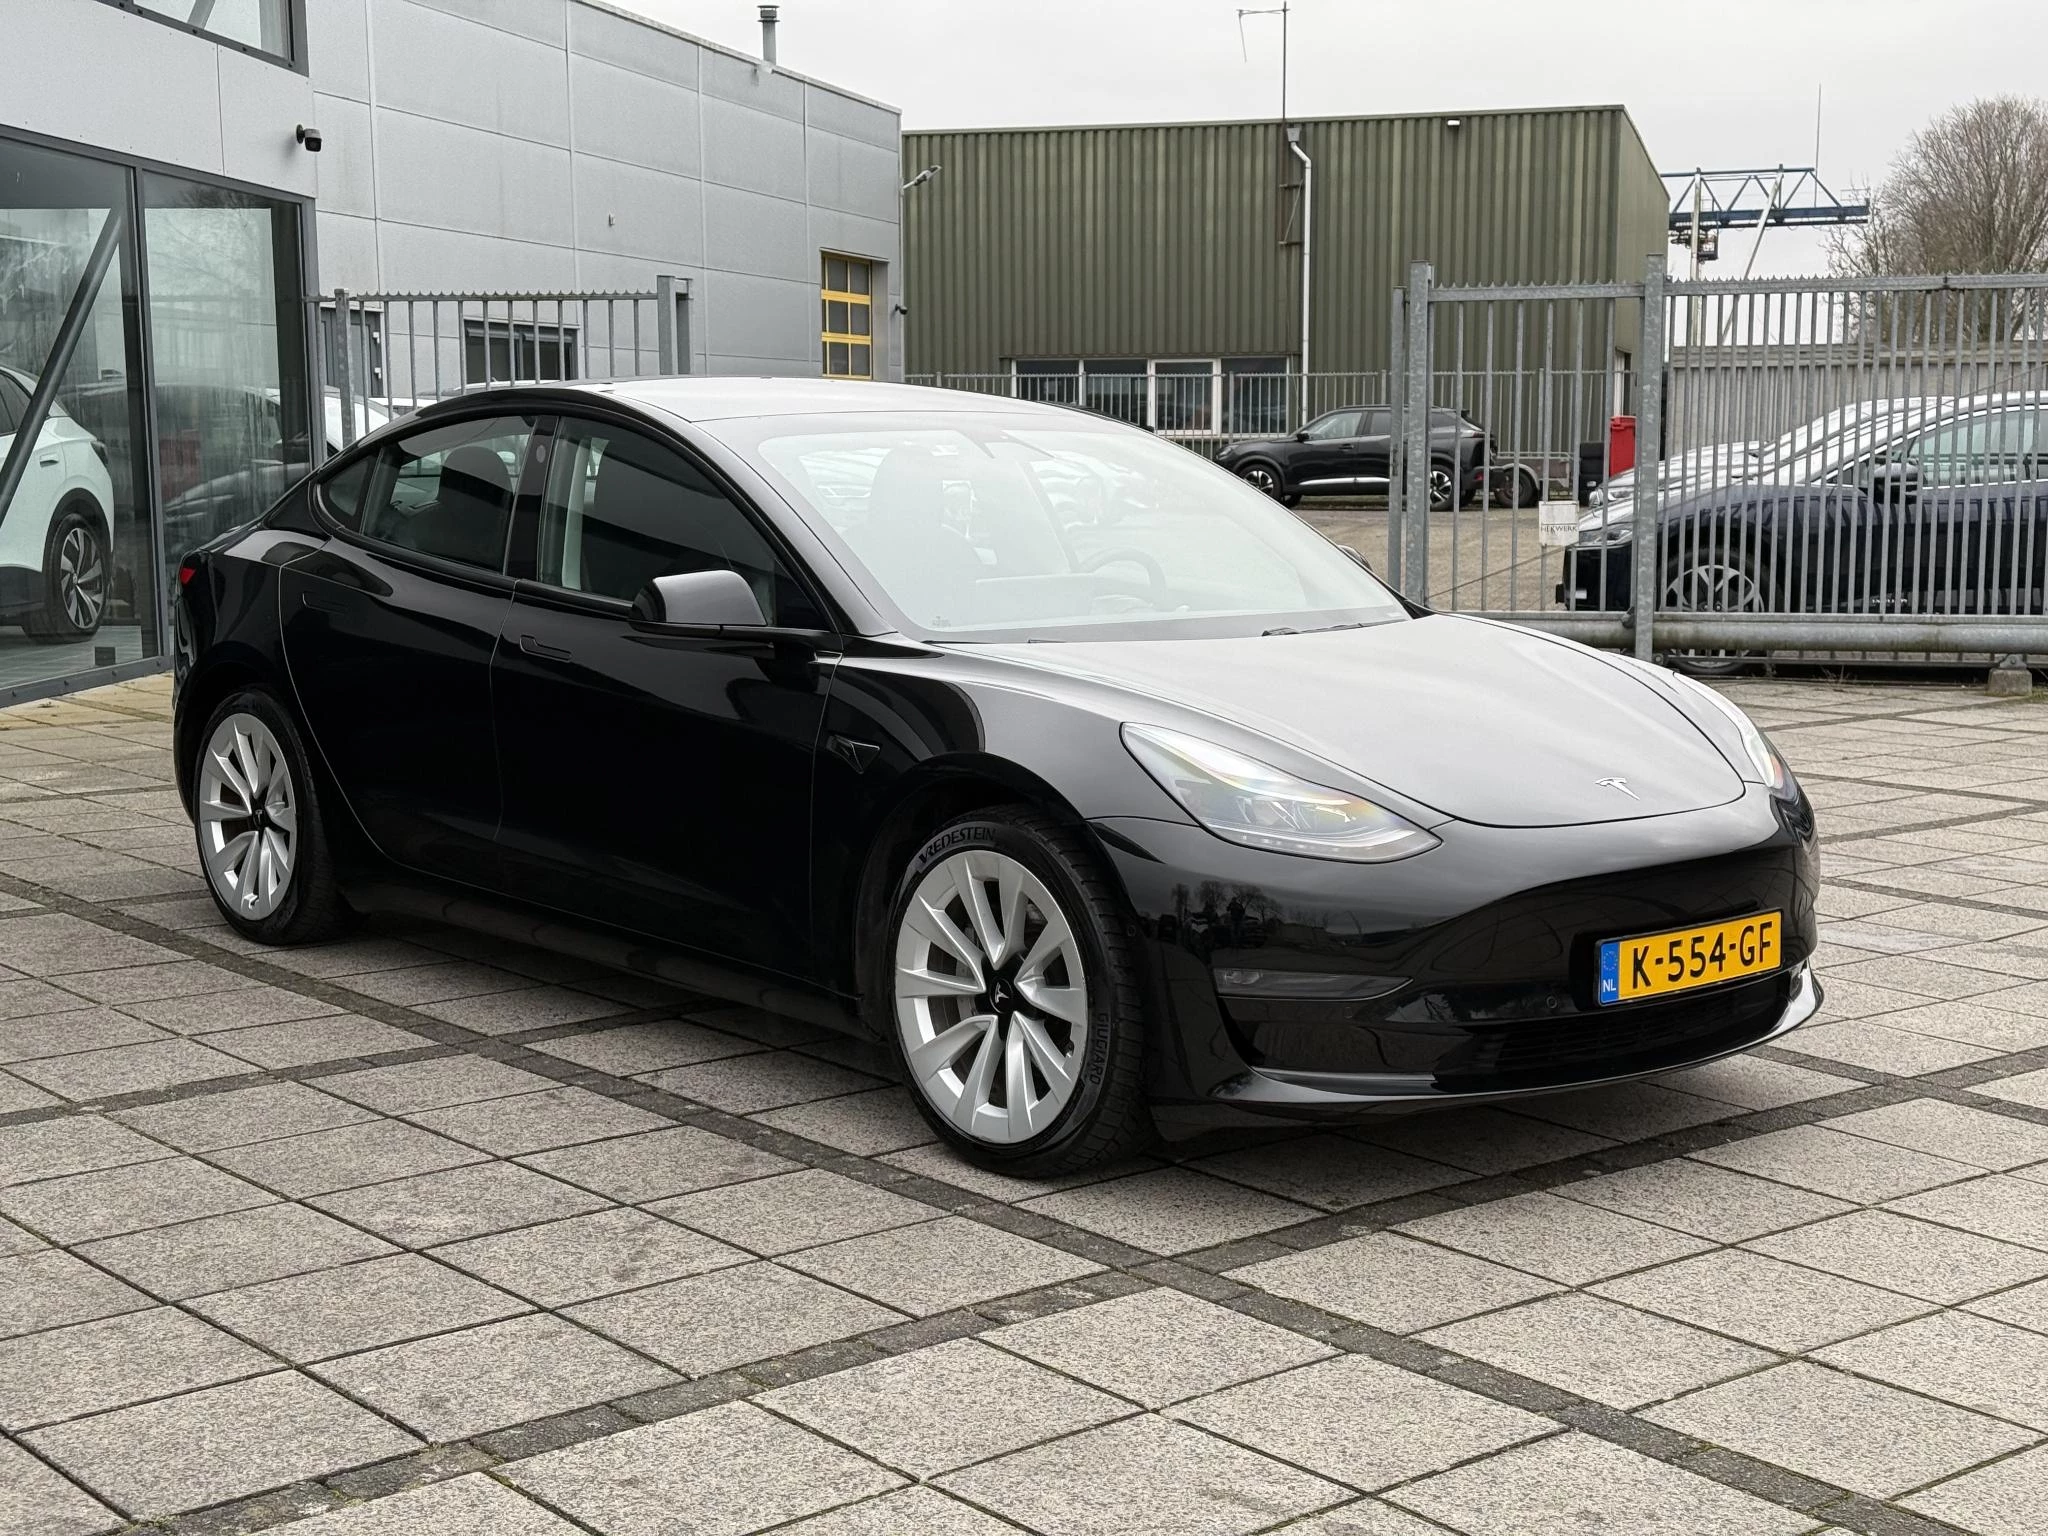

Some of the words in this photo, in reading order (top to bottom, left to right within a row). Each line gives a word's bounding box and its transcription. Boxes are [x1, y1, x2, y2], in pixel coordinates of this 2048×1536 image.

[918, 827, 996, 864] VREDESTEIN
[1632, 921, 1772, 989] K-554-GF
[1603, 980, 1616, 992] NL
[1090, 1013, 1109, 1085] GIUGIARO
